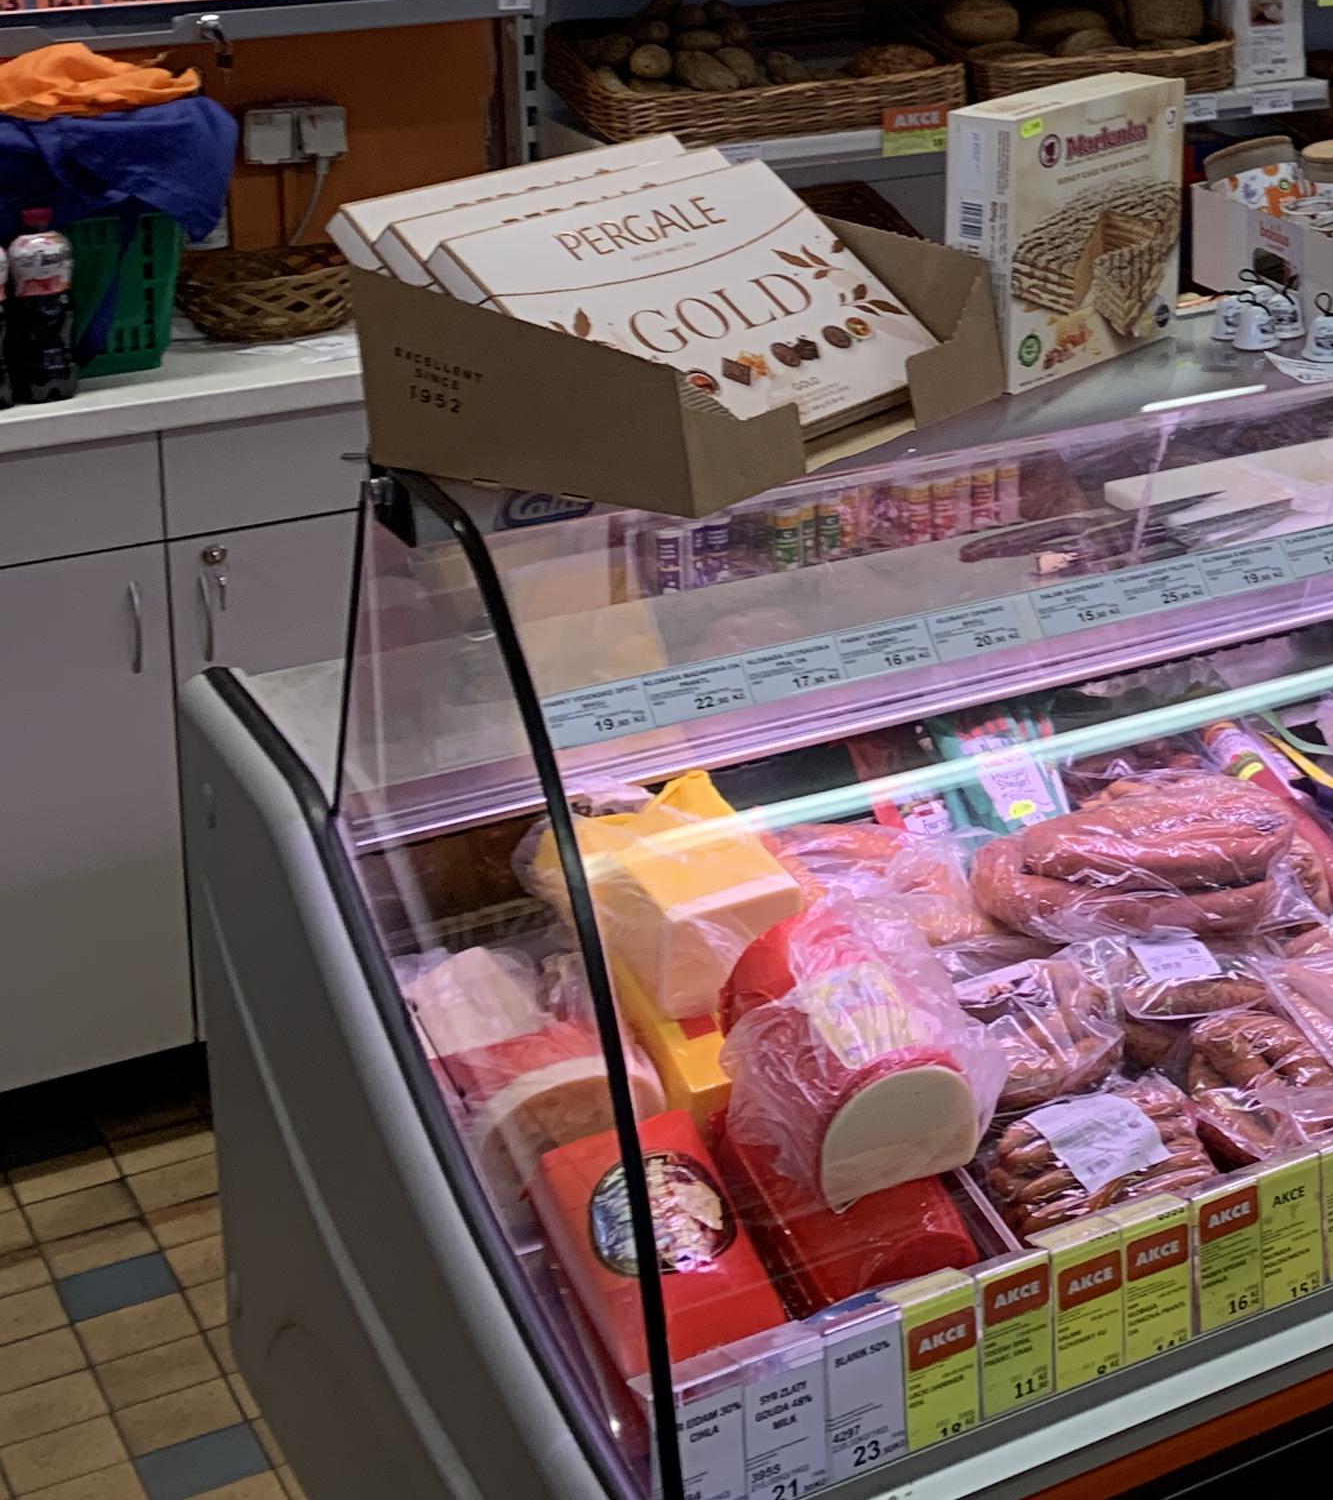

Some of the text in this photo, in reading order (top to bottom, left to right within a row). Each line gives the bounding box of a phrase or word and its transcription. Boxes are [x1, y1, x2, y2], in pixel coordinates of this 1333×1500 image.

[893, 109, 942, 131] AKCE
[552, 196, 726, 261] PERGALE
[629, 273, 812, 354] GOLD
[395, 345, 482, 384] EXCELLENT
[413, 367, 460, 391] SINCE
[408, 384, 462, 414] 1952
[1272, 1185, 1305, 1208] AKCE
[1207, 1202, 1252, 1229] AKCE
[1134, 1240, 1180, 1268] AKCE
[1067, 1266, 1113, 1295] AKCE
[994, 1280, 1041, 1310] AKCE
[1227, 1295, 1249, 1315] 16
[869, 1340, 891, 1355] 50%
[918, 1324, 966, 1354] AKCE
[1014, 1380, 1035, 1400] 11
[720, 1401, 743, 1417] 30%
[772, 1415, 798, 1431] MILK
[831, 1424, 862, 1444] 4297
[852, 1440, 881, 1467] 23
[771, 1478, 799, 1500] 21
